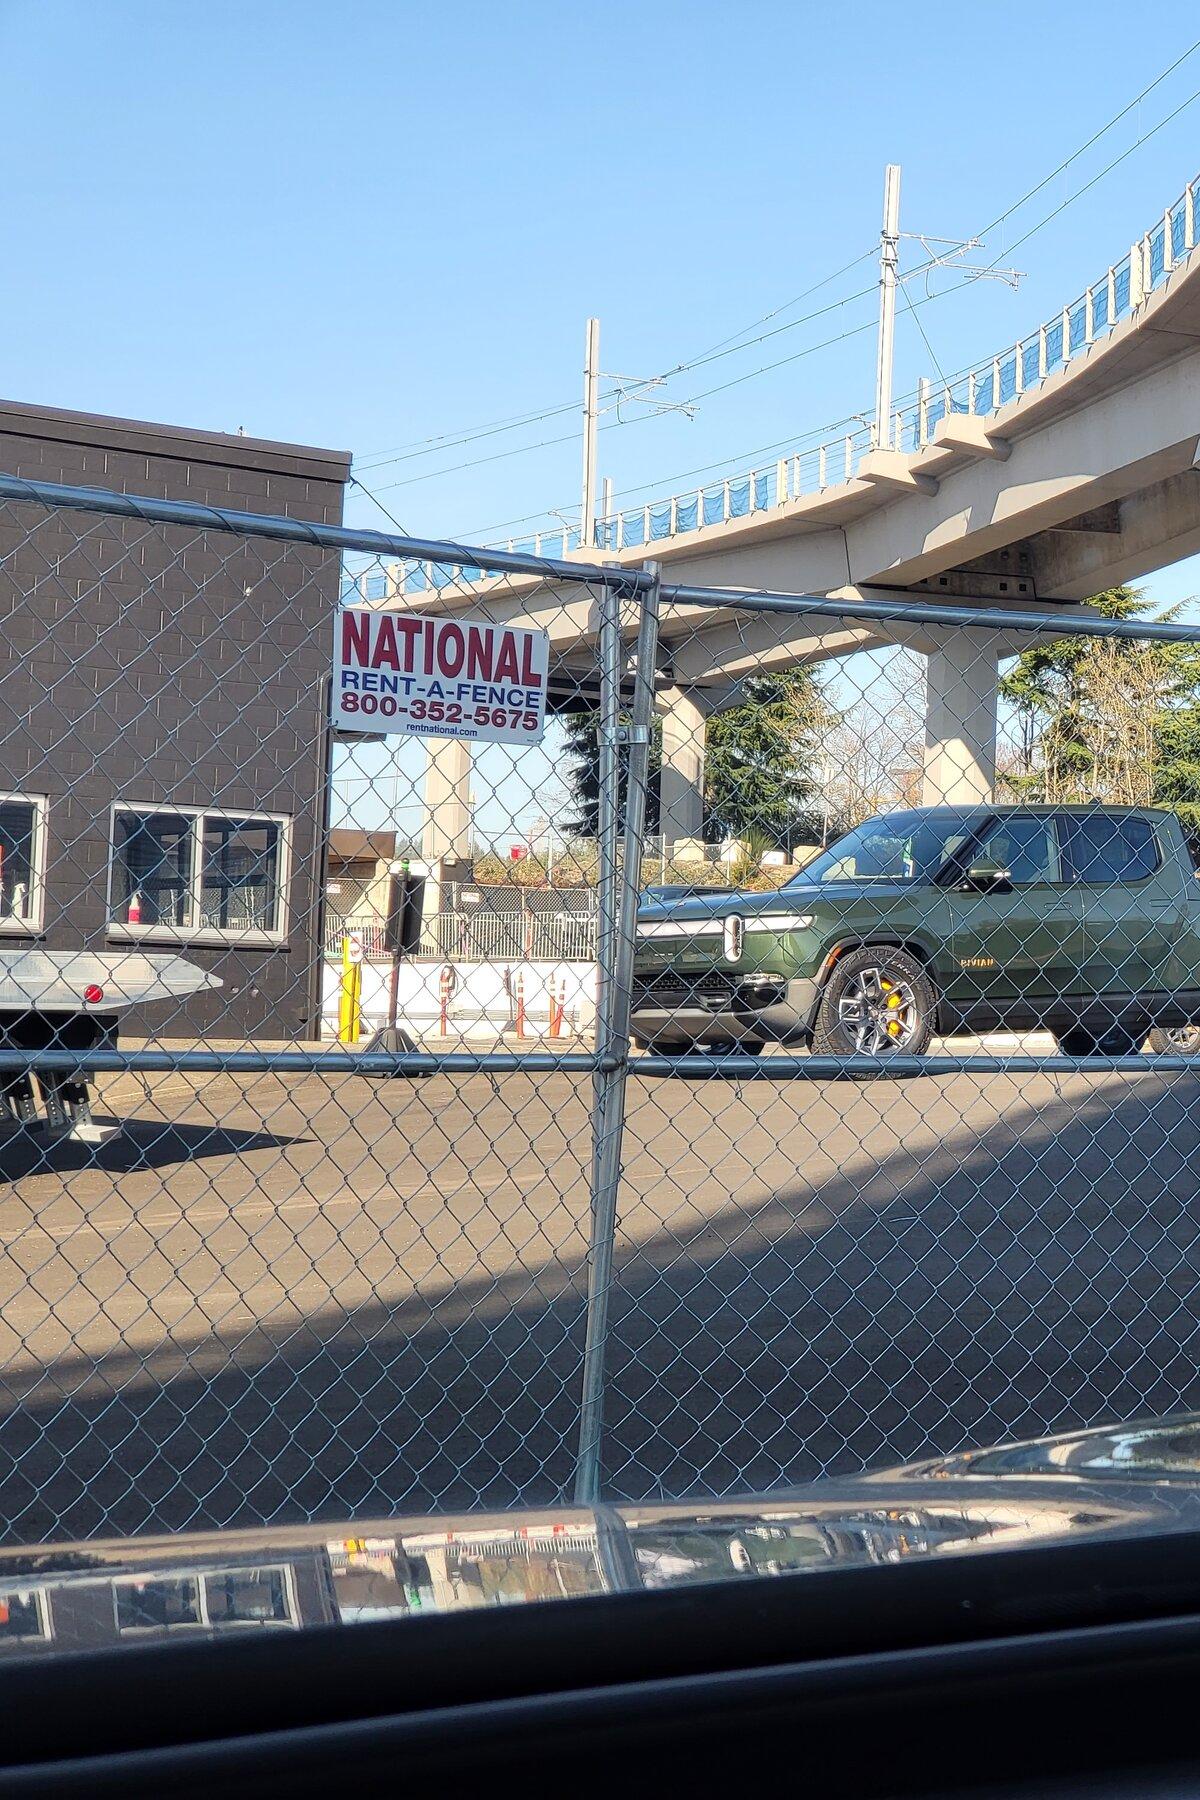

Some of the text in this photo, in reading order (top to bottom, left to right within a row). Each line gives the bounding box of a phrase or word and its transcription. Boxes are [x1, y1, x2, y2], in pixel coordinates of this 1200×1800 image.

[341, 610, 542, 688] NATIONAL
[341, 669, 541, 709] RENT-A-FENCE
[340, 691, 538, 731] 800-352-5675
[406, 722, 478, 737] rentnational.com
